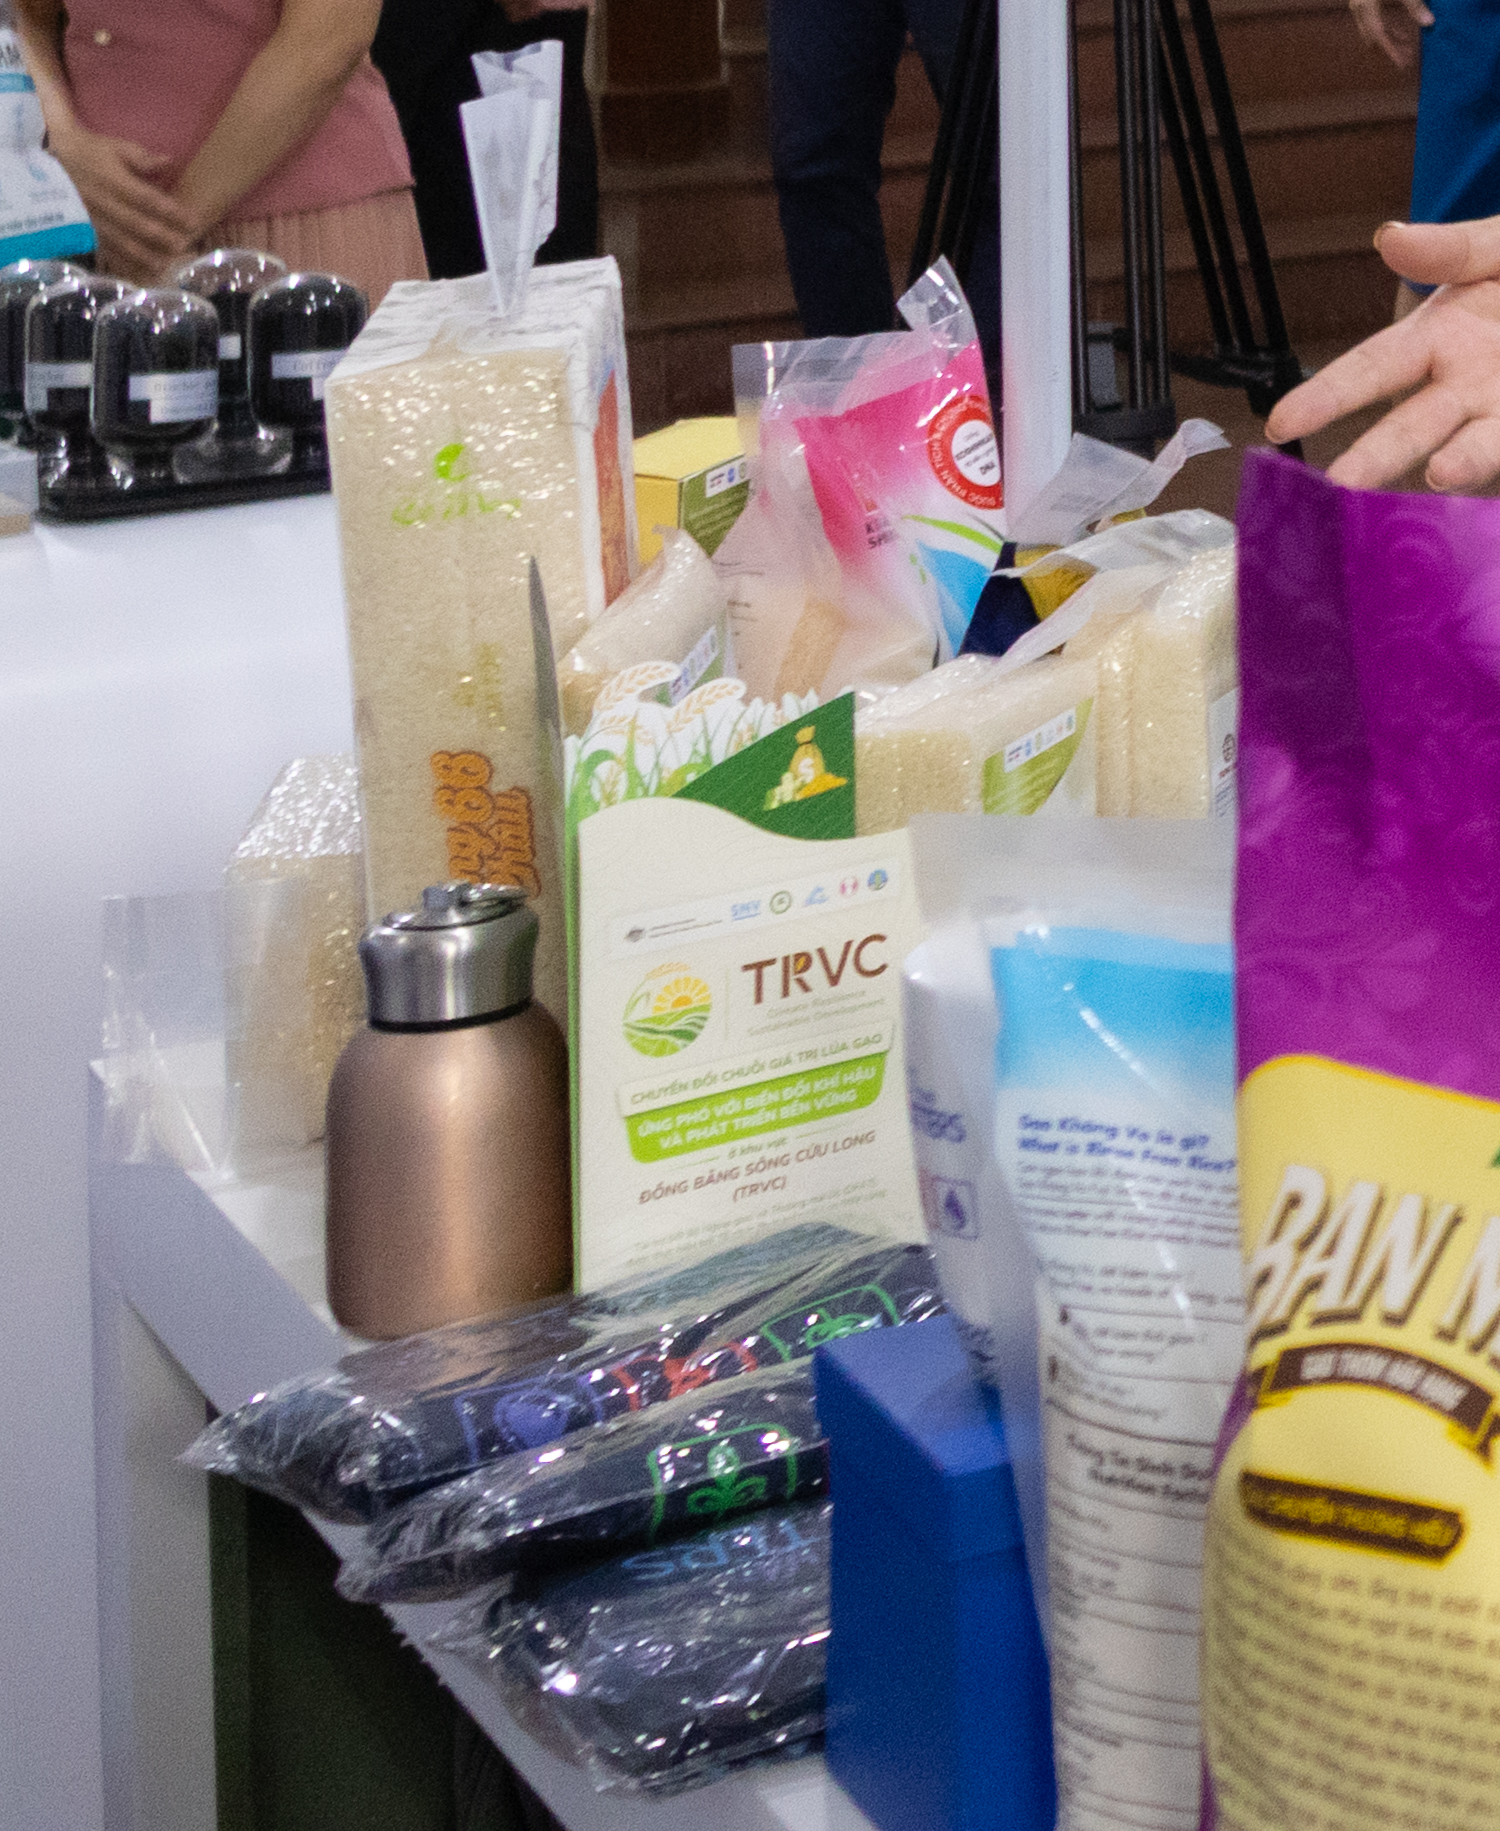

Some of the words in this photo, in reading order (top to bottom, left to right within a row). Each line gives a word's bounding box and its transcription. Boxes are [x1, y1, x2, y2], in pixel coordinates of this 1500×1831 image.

[741, 933, 888, 1005] TRVC
[833, 1129, 876, 1155] LONG
[1247, 1162, 1466, 1341] BAN
